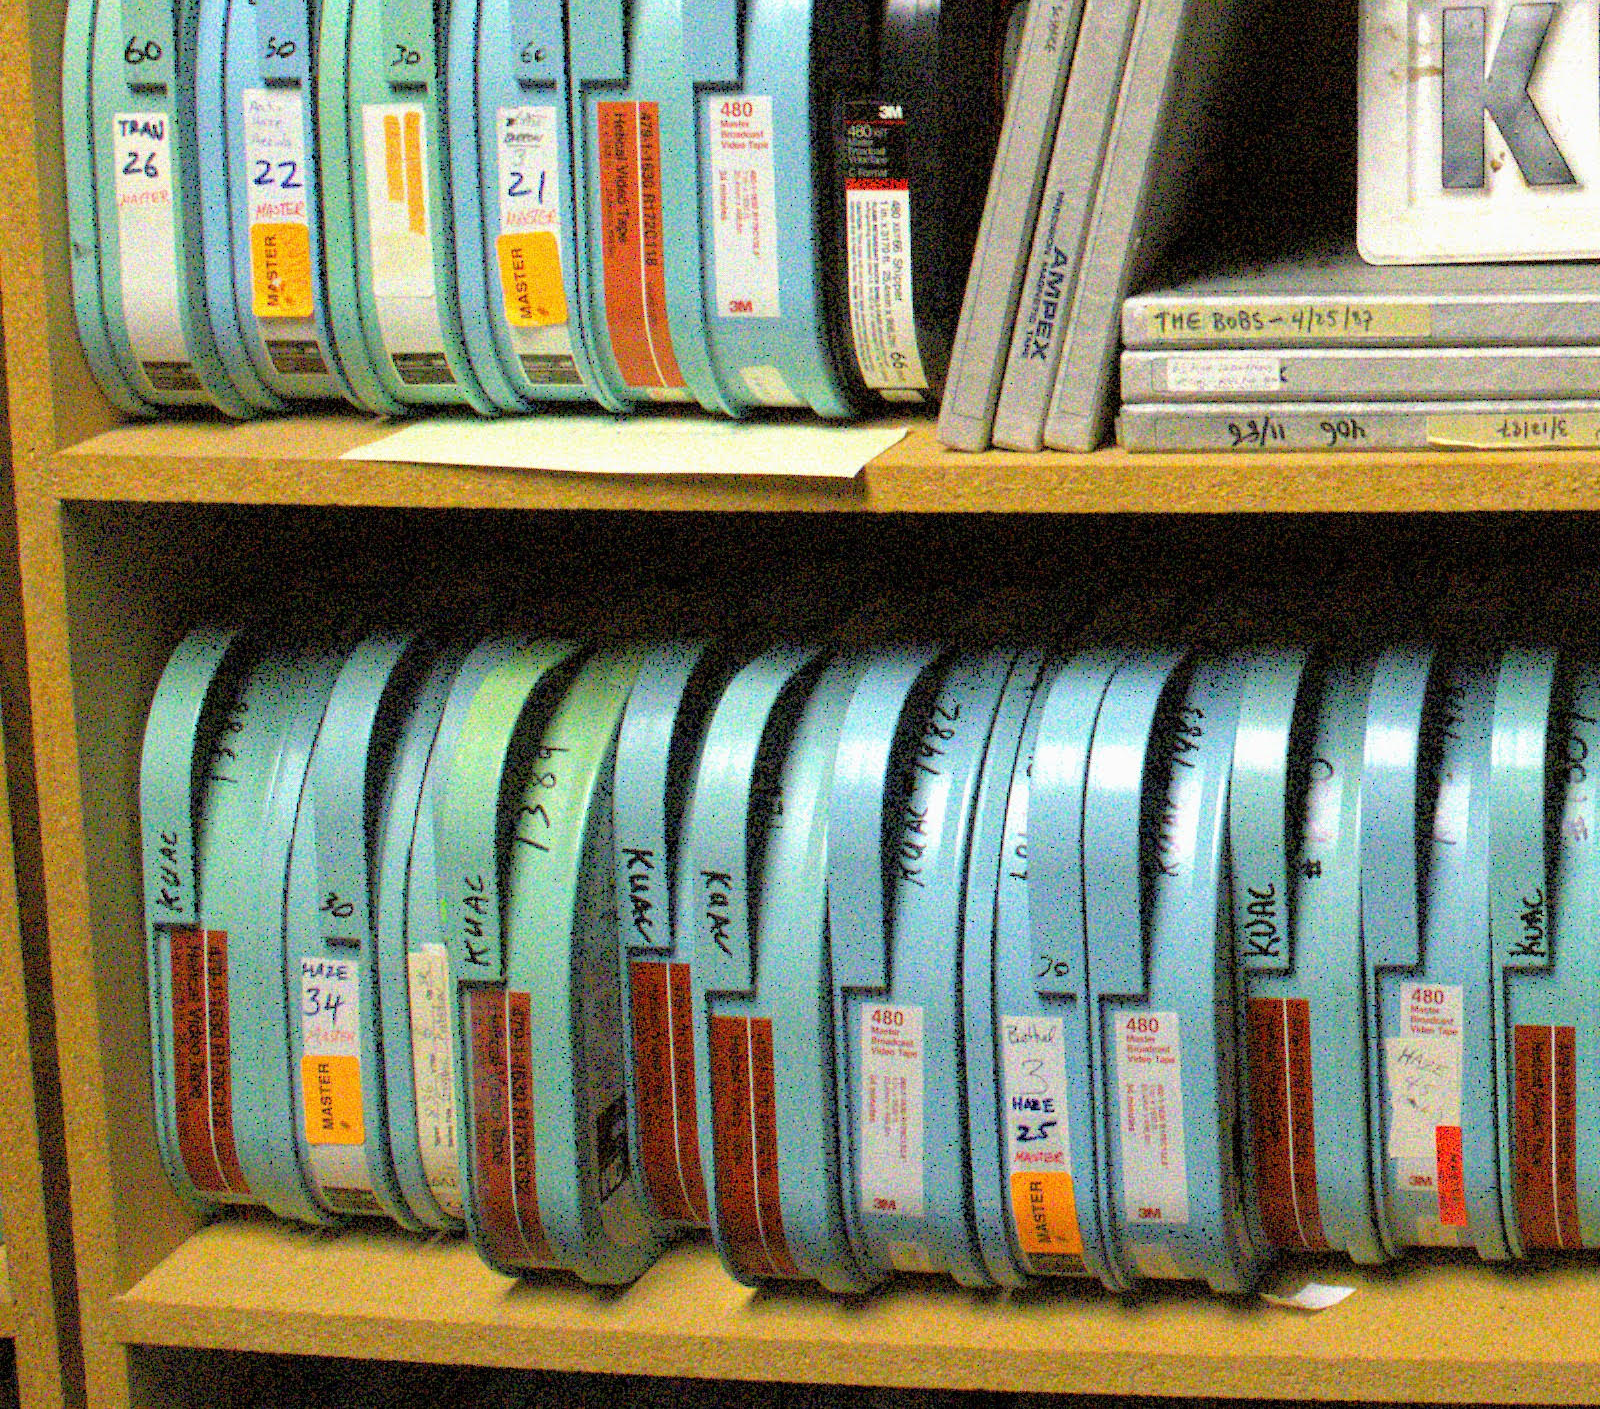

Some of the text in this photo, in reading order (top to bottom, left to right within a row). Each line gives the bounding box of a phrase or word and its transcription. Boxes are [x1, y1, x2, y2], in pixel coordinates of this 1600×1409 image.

[124, 36, 163, 65] 60
[720, 101, 753, 119] 480
[879, 105, 904, 120] 3M
[117, 119, 165, 140] TRAN
[720, 120, 750, 129] Master
[720, 130, 764, 139] Broadcast
[720, 140, 769, 151] Video Tape
[122, 151, 159, 178] 26
[253, 160, 303, 189] 22
[613, 112, 631, 244] Helical Video Tape
[507, 170, 547, 204] 21
[255, 201, 305, 217] MASTER
[1044, 191, 1065, 255] PRECISION
[266, 234, 278, 307] MASTER
[513, 245, 530, 321] MASTER
[892, 258, 905, 302] Shipper
[728, 299, 754, 314] 3M
[1030, 246, 1069, 361] AMPEX
[1154, 313, 1202, 330] THE
[1213, 312, 1264, 330] BOBS
[891, 351, 907, 370] 66
[1319, 418, 1368, 447] 406
[462, 745, 569, 966] KUAC 1389
[900, 805, 929, 888] KUAC
[157, 830, 183, 907] KUAC
[621, 847, 654, 945] KUAC
[1244, 882, 1278, 957] KUAC
[1509, 888, 1546, 957] KUAC
[302, 962, 348, 980] HAZE
[303, 986, 344, 1022] 34
[1411, 989, 1445, 1005] 480
[871, 1009, 905, 1027] 480
[1410, 1005, 1441, 1015] Master
[1125, 1017, 1160, 1034] 480
[1410, 1015, 1455, 1025] Broadcast
[188, 1006, 202, 1056] Video
[870, 1027, 901, 1037] Master
[1125, 1034, 1157, 1044] Master
[1410, 1024, 1459, 1036] Video Tape
[871, 1037, 916, 1048] Broadcast
[1125, 1044, 1172, 1055] Broadcast
[871, 1047, 918, 1059] Video Tape
[1125, 1054, 1177, 1065] Video Tape
[1397, 1047, 1448, 1076] HAZE
[319, 1061, 332, 1132] MASTER
[1012, 1095, 1056, 1113] HAZE
[1016, 1121, 1058, 1141] 25
[1408, 1175, 1433, 1187] 3M
[872, 1197, 898, 1211] 3M
[1030, 1179, 1046, 1245] MASTER
[1136, 1206, 1163, 1220] 3M
